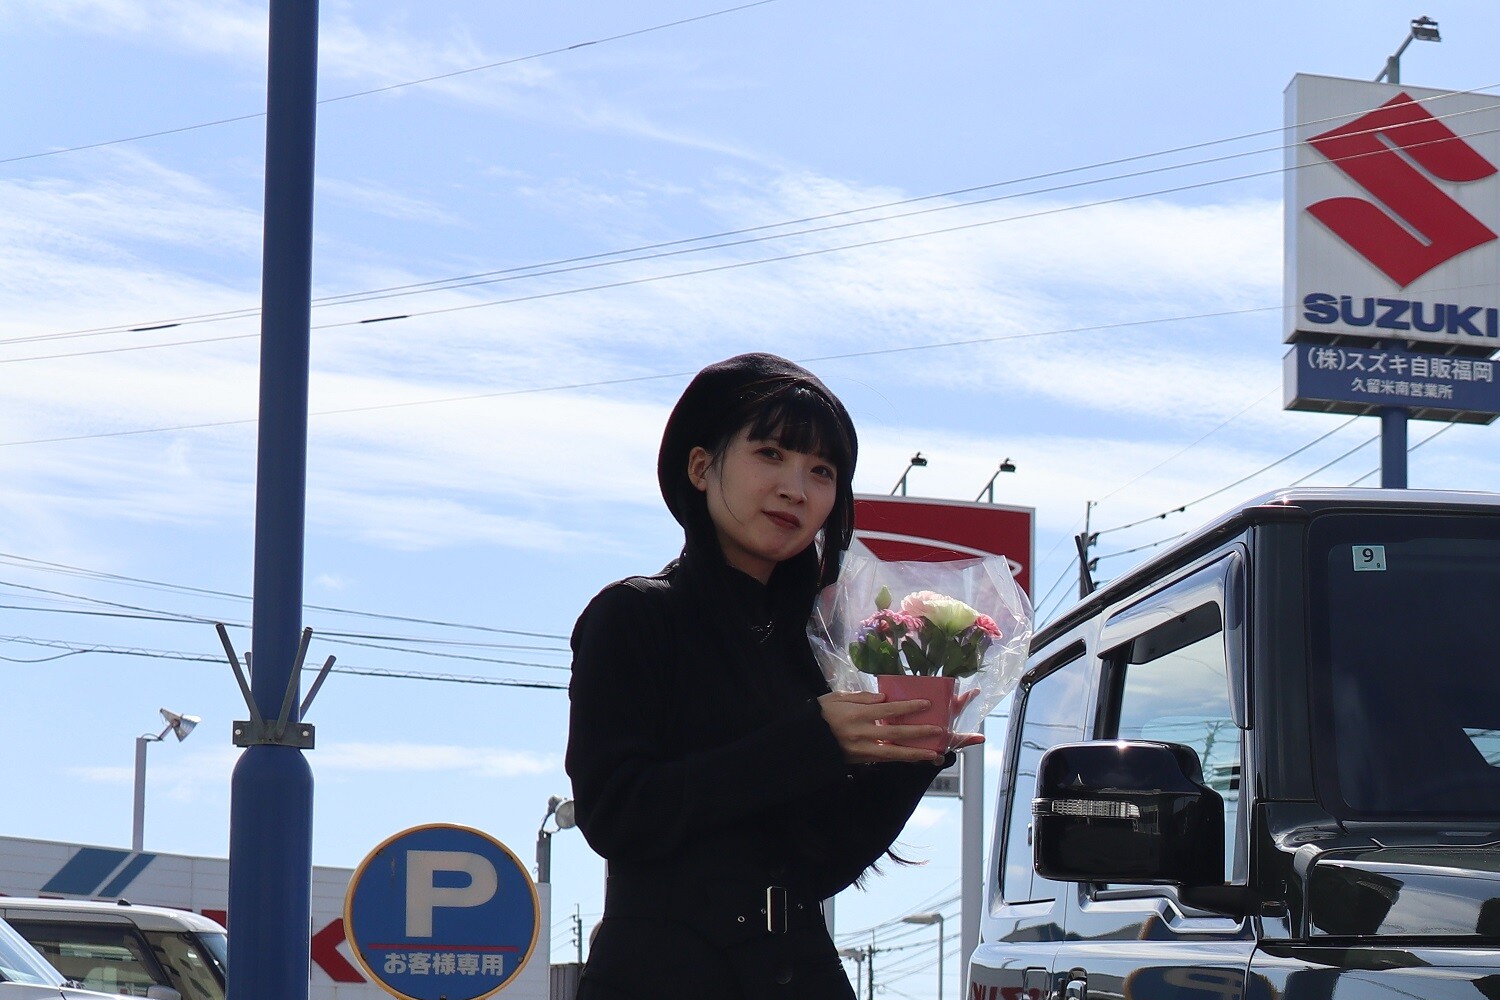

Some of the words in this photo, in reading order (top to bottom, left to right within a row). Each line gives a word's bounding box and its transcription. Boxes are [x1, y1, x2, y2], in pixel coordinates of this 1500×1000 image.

[1303, 293, 1499, 337] SUZUKI
[1307, 346, 1493, 383] (株)スズキ自販福岡
[1351, 377, 1453, 399] 久留米南営業所
[1362, 548, 1374, 563] 9
[405, 850, 498, 938] P
[383, 952, 504, 976] お客様専用
